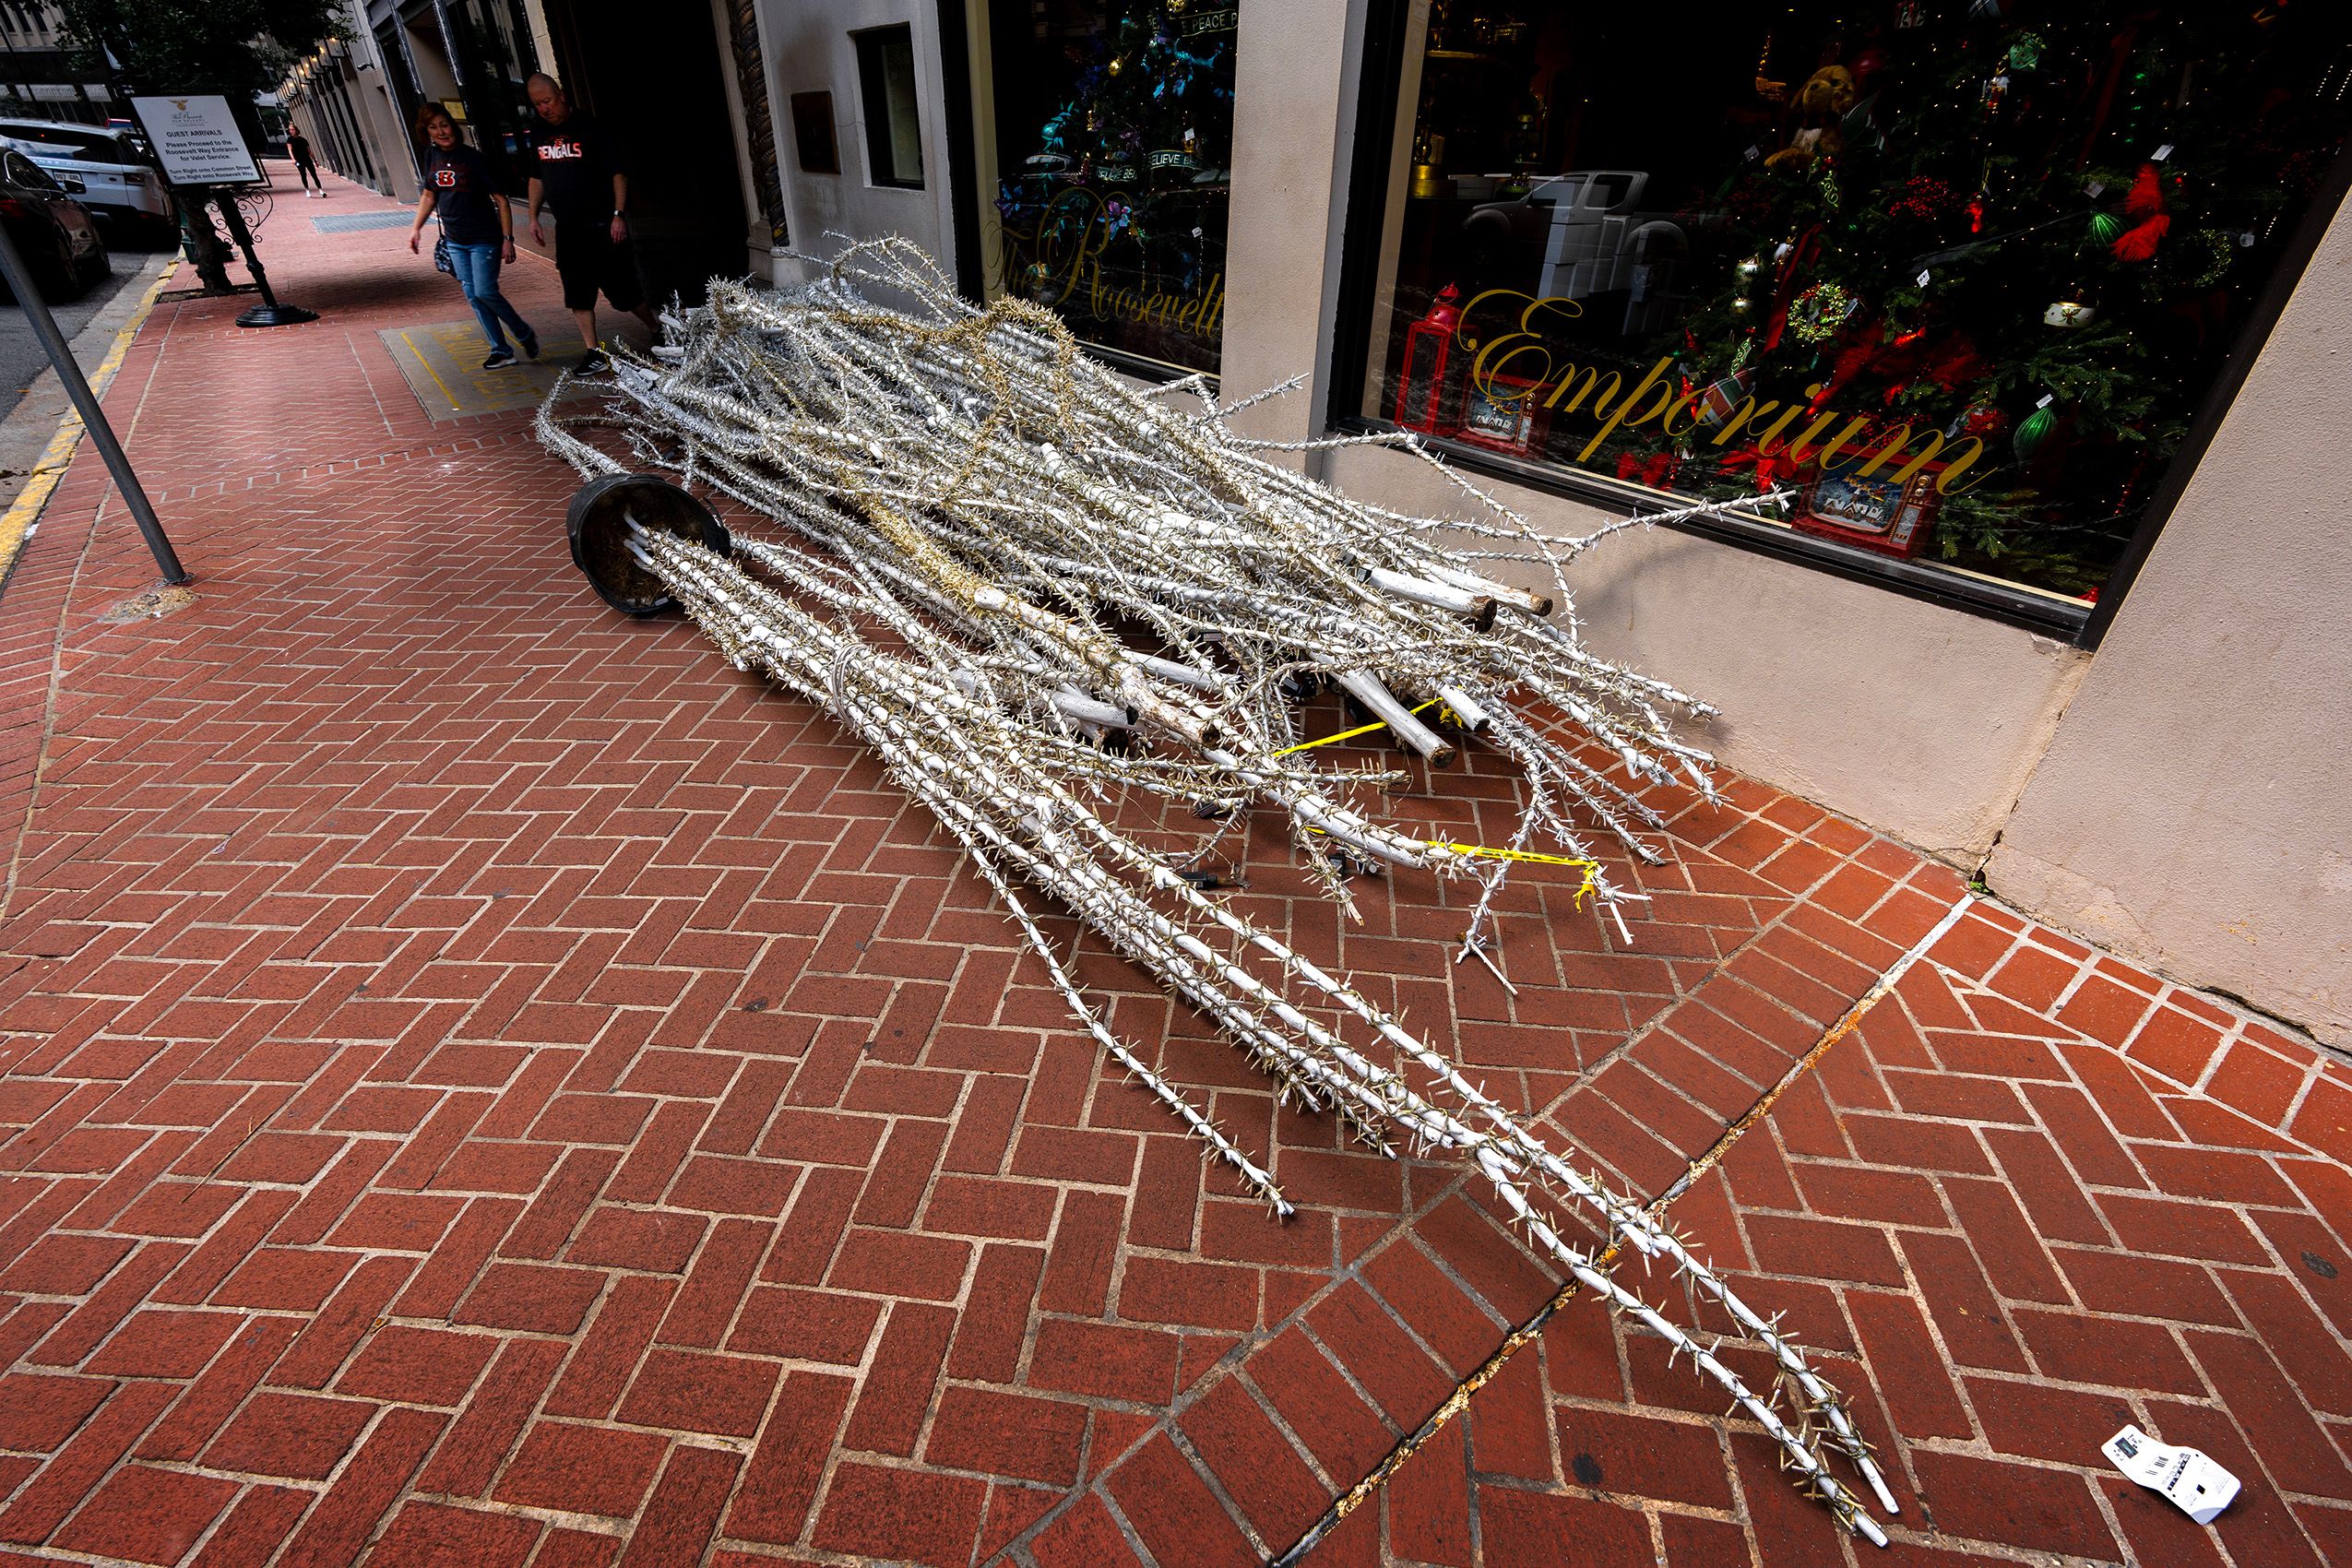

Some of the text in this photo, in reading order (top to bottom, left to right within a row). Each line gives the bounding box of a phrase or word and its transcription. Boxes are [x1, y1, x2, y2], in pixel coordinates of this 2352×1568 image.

[1192, 14, 1226, 31] PEACE
[538, 142, 582, 160] BENGALS
[1149, 153, 1181, 166] ELIEVE
[1037, 187, 1225, 339] Roosevelt
[1457, 289, 1998, 495] Emporium
